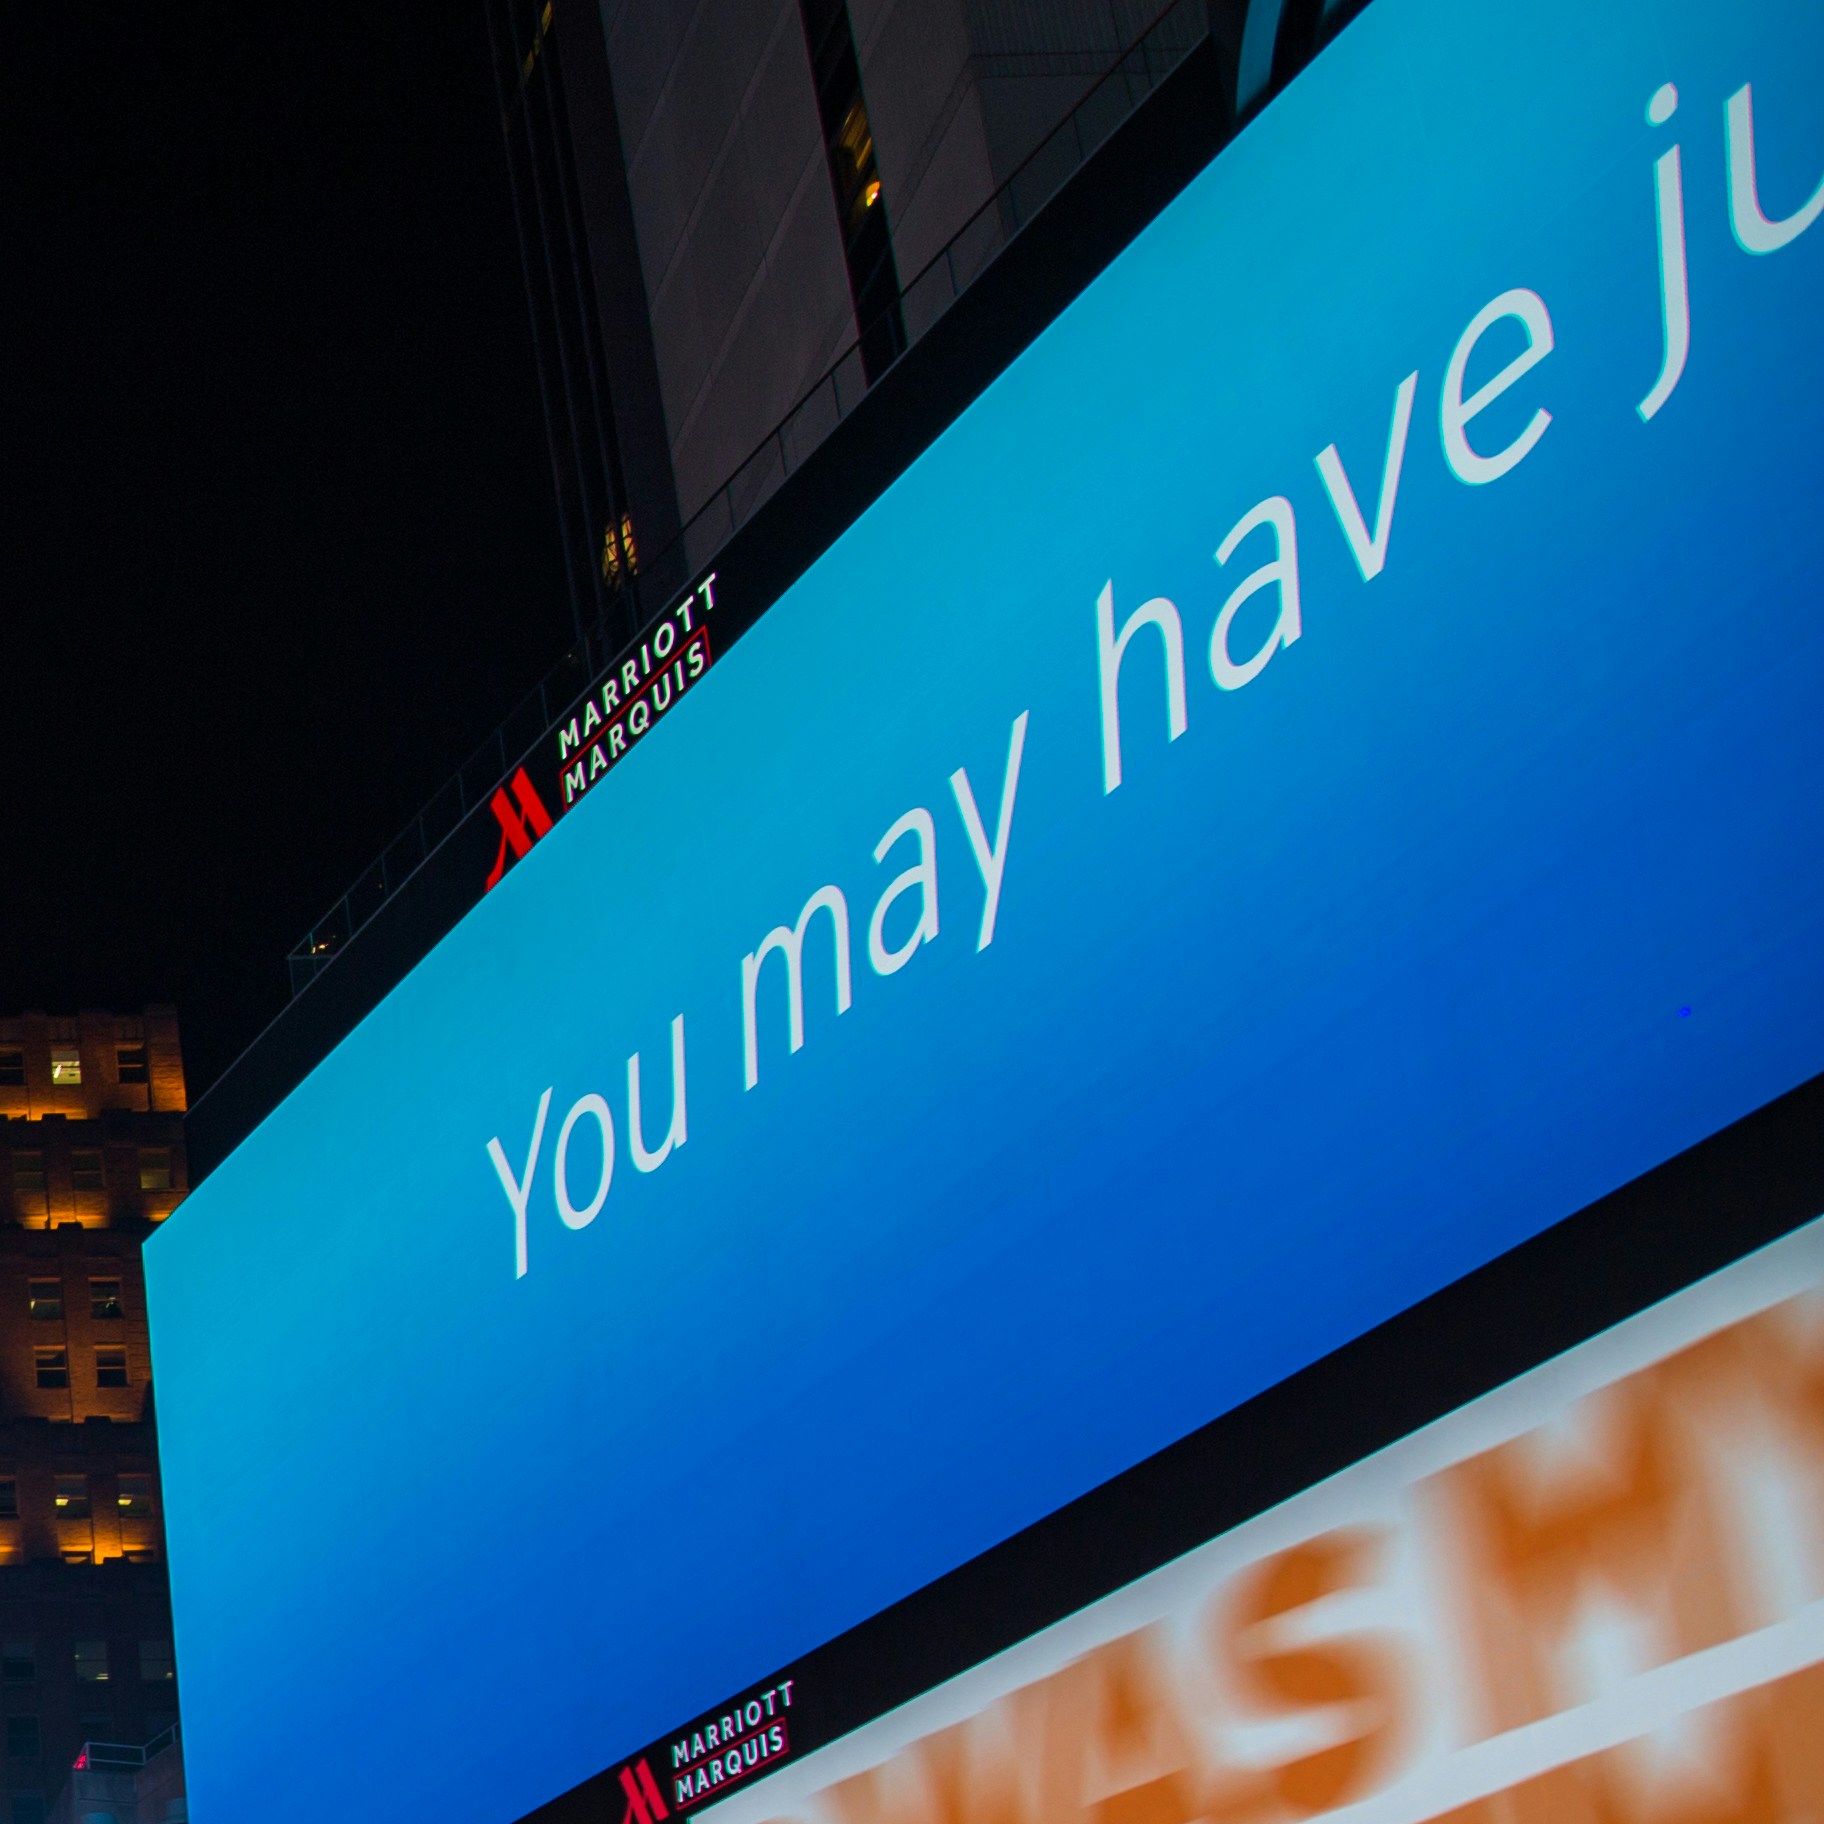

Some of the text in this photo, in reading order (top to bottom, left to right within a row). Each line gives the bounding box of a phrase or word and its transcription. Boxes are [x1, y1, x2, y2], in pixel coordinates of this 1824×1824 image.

[559, 572, 717, 760] MARRIOTT
[564, 641, 705, 803] MARQUIS
[487, 1012, 688, 1281] You
[740, 708, 1029, 1092] may
[1096, 286, 1555, 798] have
[670, 1679, 794, 1769] MARRIOTT
[675, 1725, 784, 1803] MARQUIS
